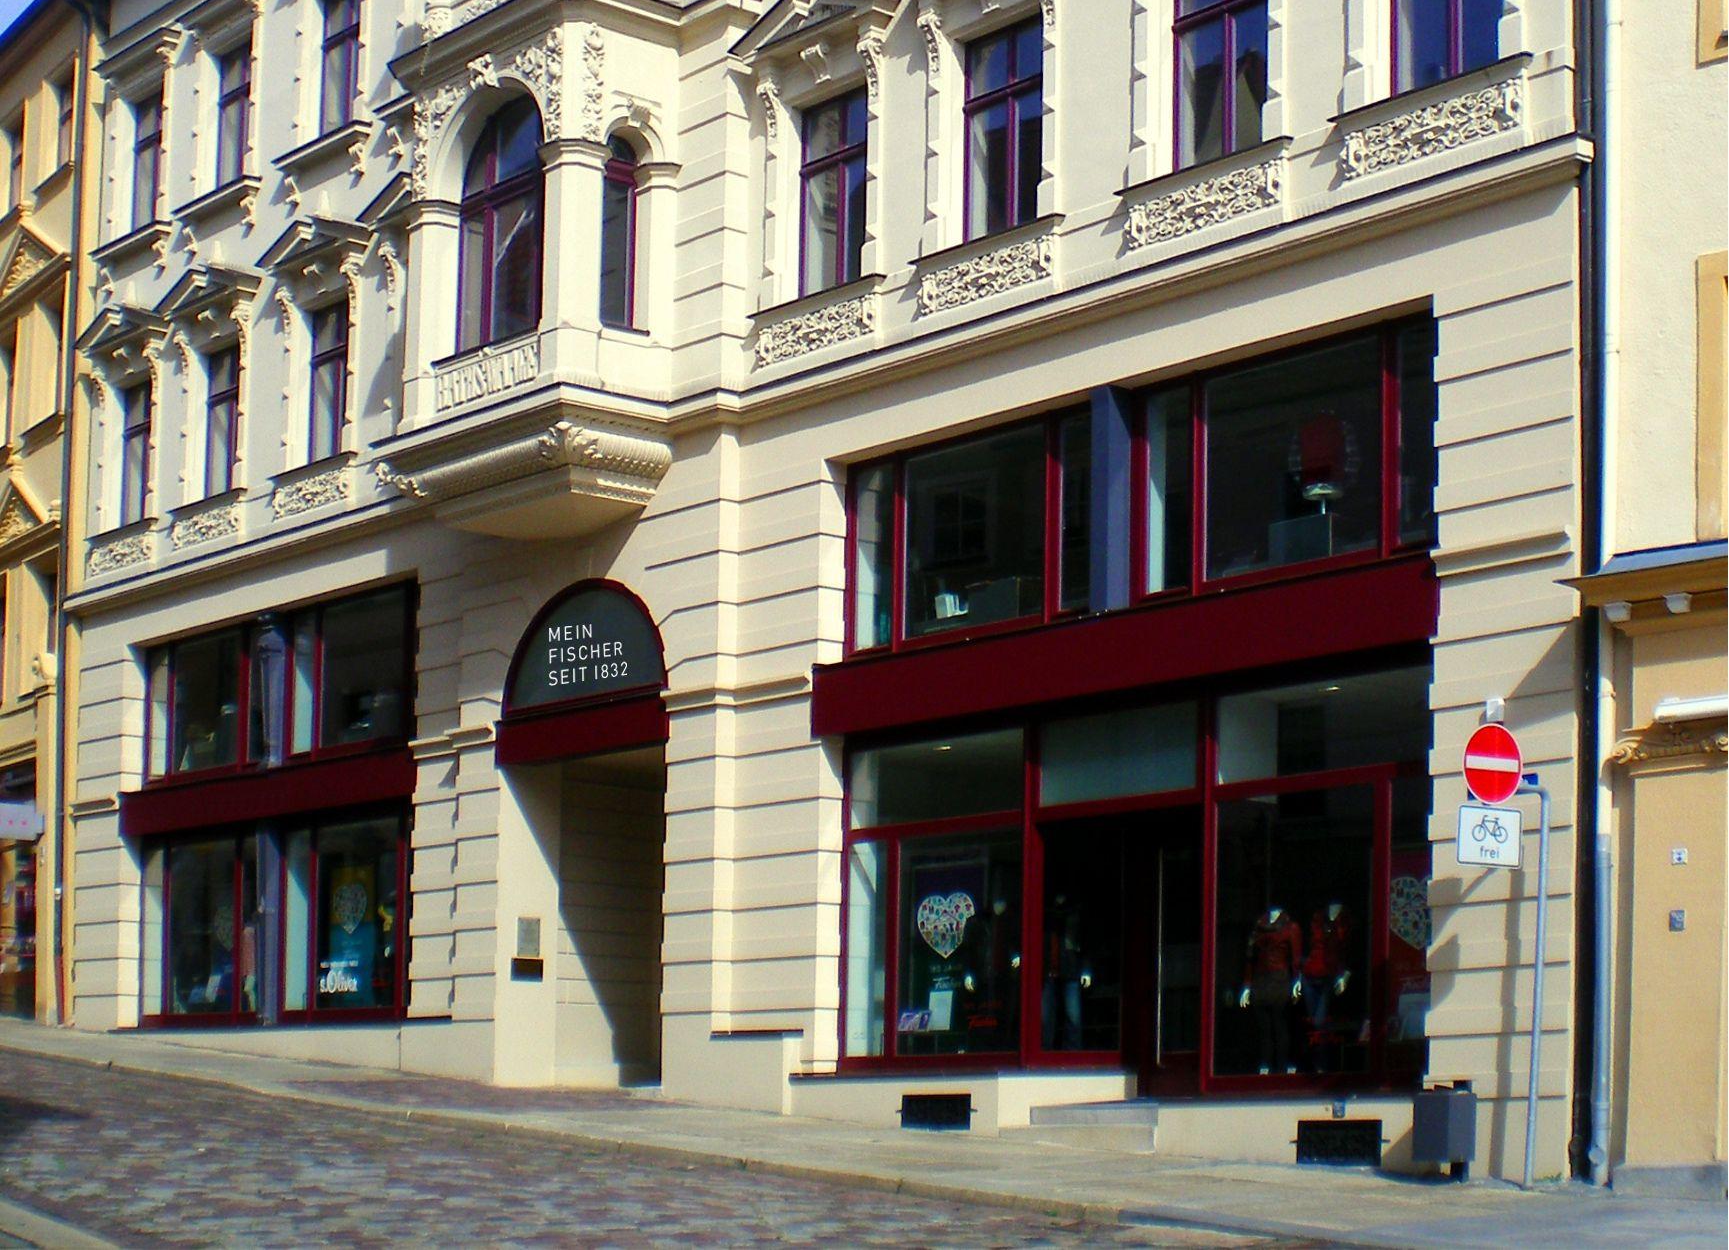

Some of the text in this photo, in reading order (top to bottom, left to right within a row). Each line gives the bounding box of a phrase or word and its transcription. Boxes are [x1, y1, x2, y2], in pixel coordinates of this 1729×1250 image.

[548, 624, 593, 642] MEIN
[548, 642, 623, 664] FISCHER
[548, 661, 628, 686] SEIT 1832
[1480, 845, 1499, 858] frei
